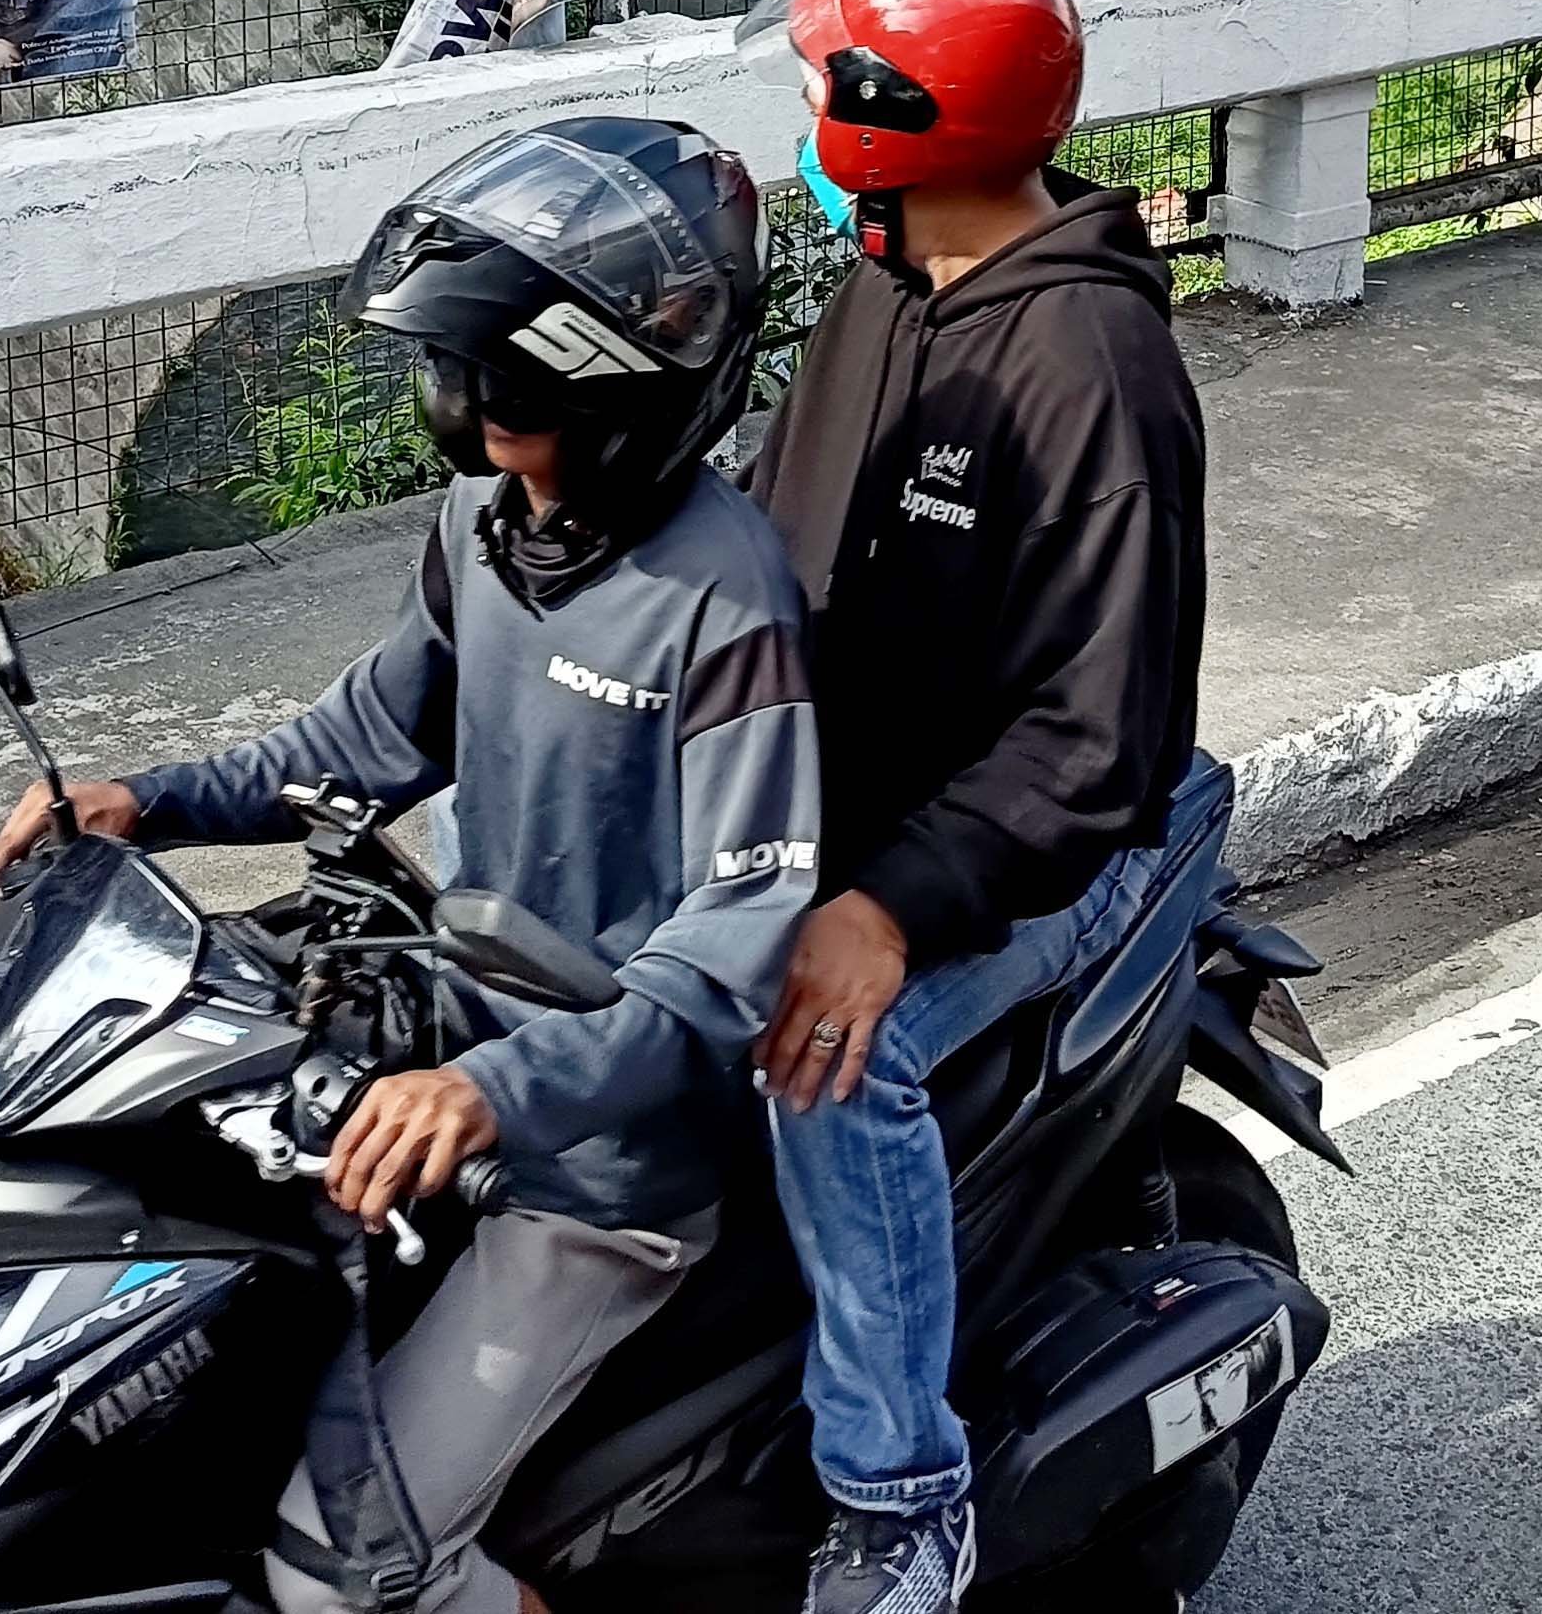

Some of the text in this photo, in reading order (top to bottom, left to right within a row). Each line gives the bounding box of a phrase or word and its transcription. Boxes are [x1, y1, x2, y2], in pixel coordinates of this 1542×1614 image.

[899, 478, 976, 531] Supreme
[546, 655, 670, 712] MOVE IT
[715, 842, 816, 877] MOVE
[70, 1328, 213, 1446] YAMAHA
